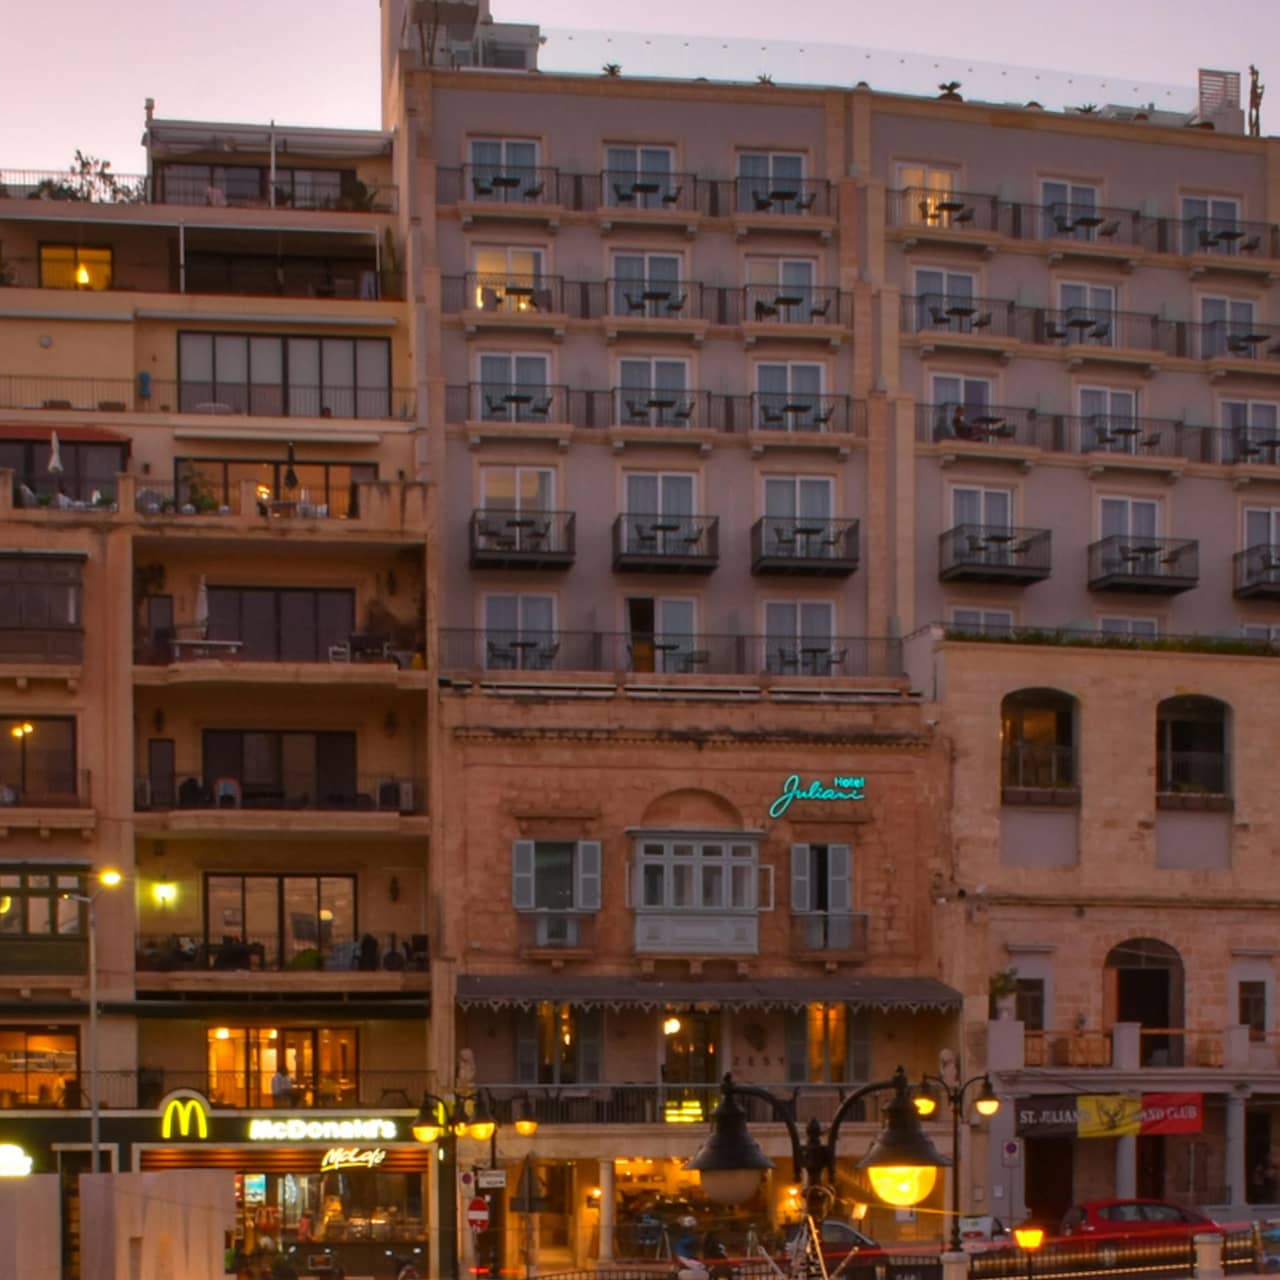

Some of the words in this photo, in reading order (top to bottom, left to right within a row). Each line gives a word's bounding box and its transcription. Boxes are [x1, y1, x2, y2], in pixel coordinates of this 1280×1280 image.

[1020, 1111, 1040, 1125] ST.
[1167, 1105, 1197, 1119] CLUB
[249, 1120, 397, 1140] McDonald's
